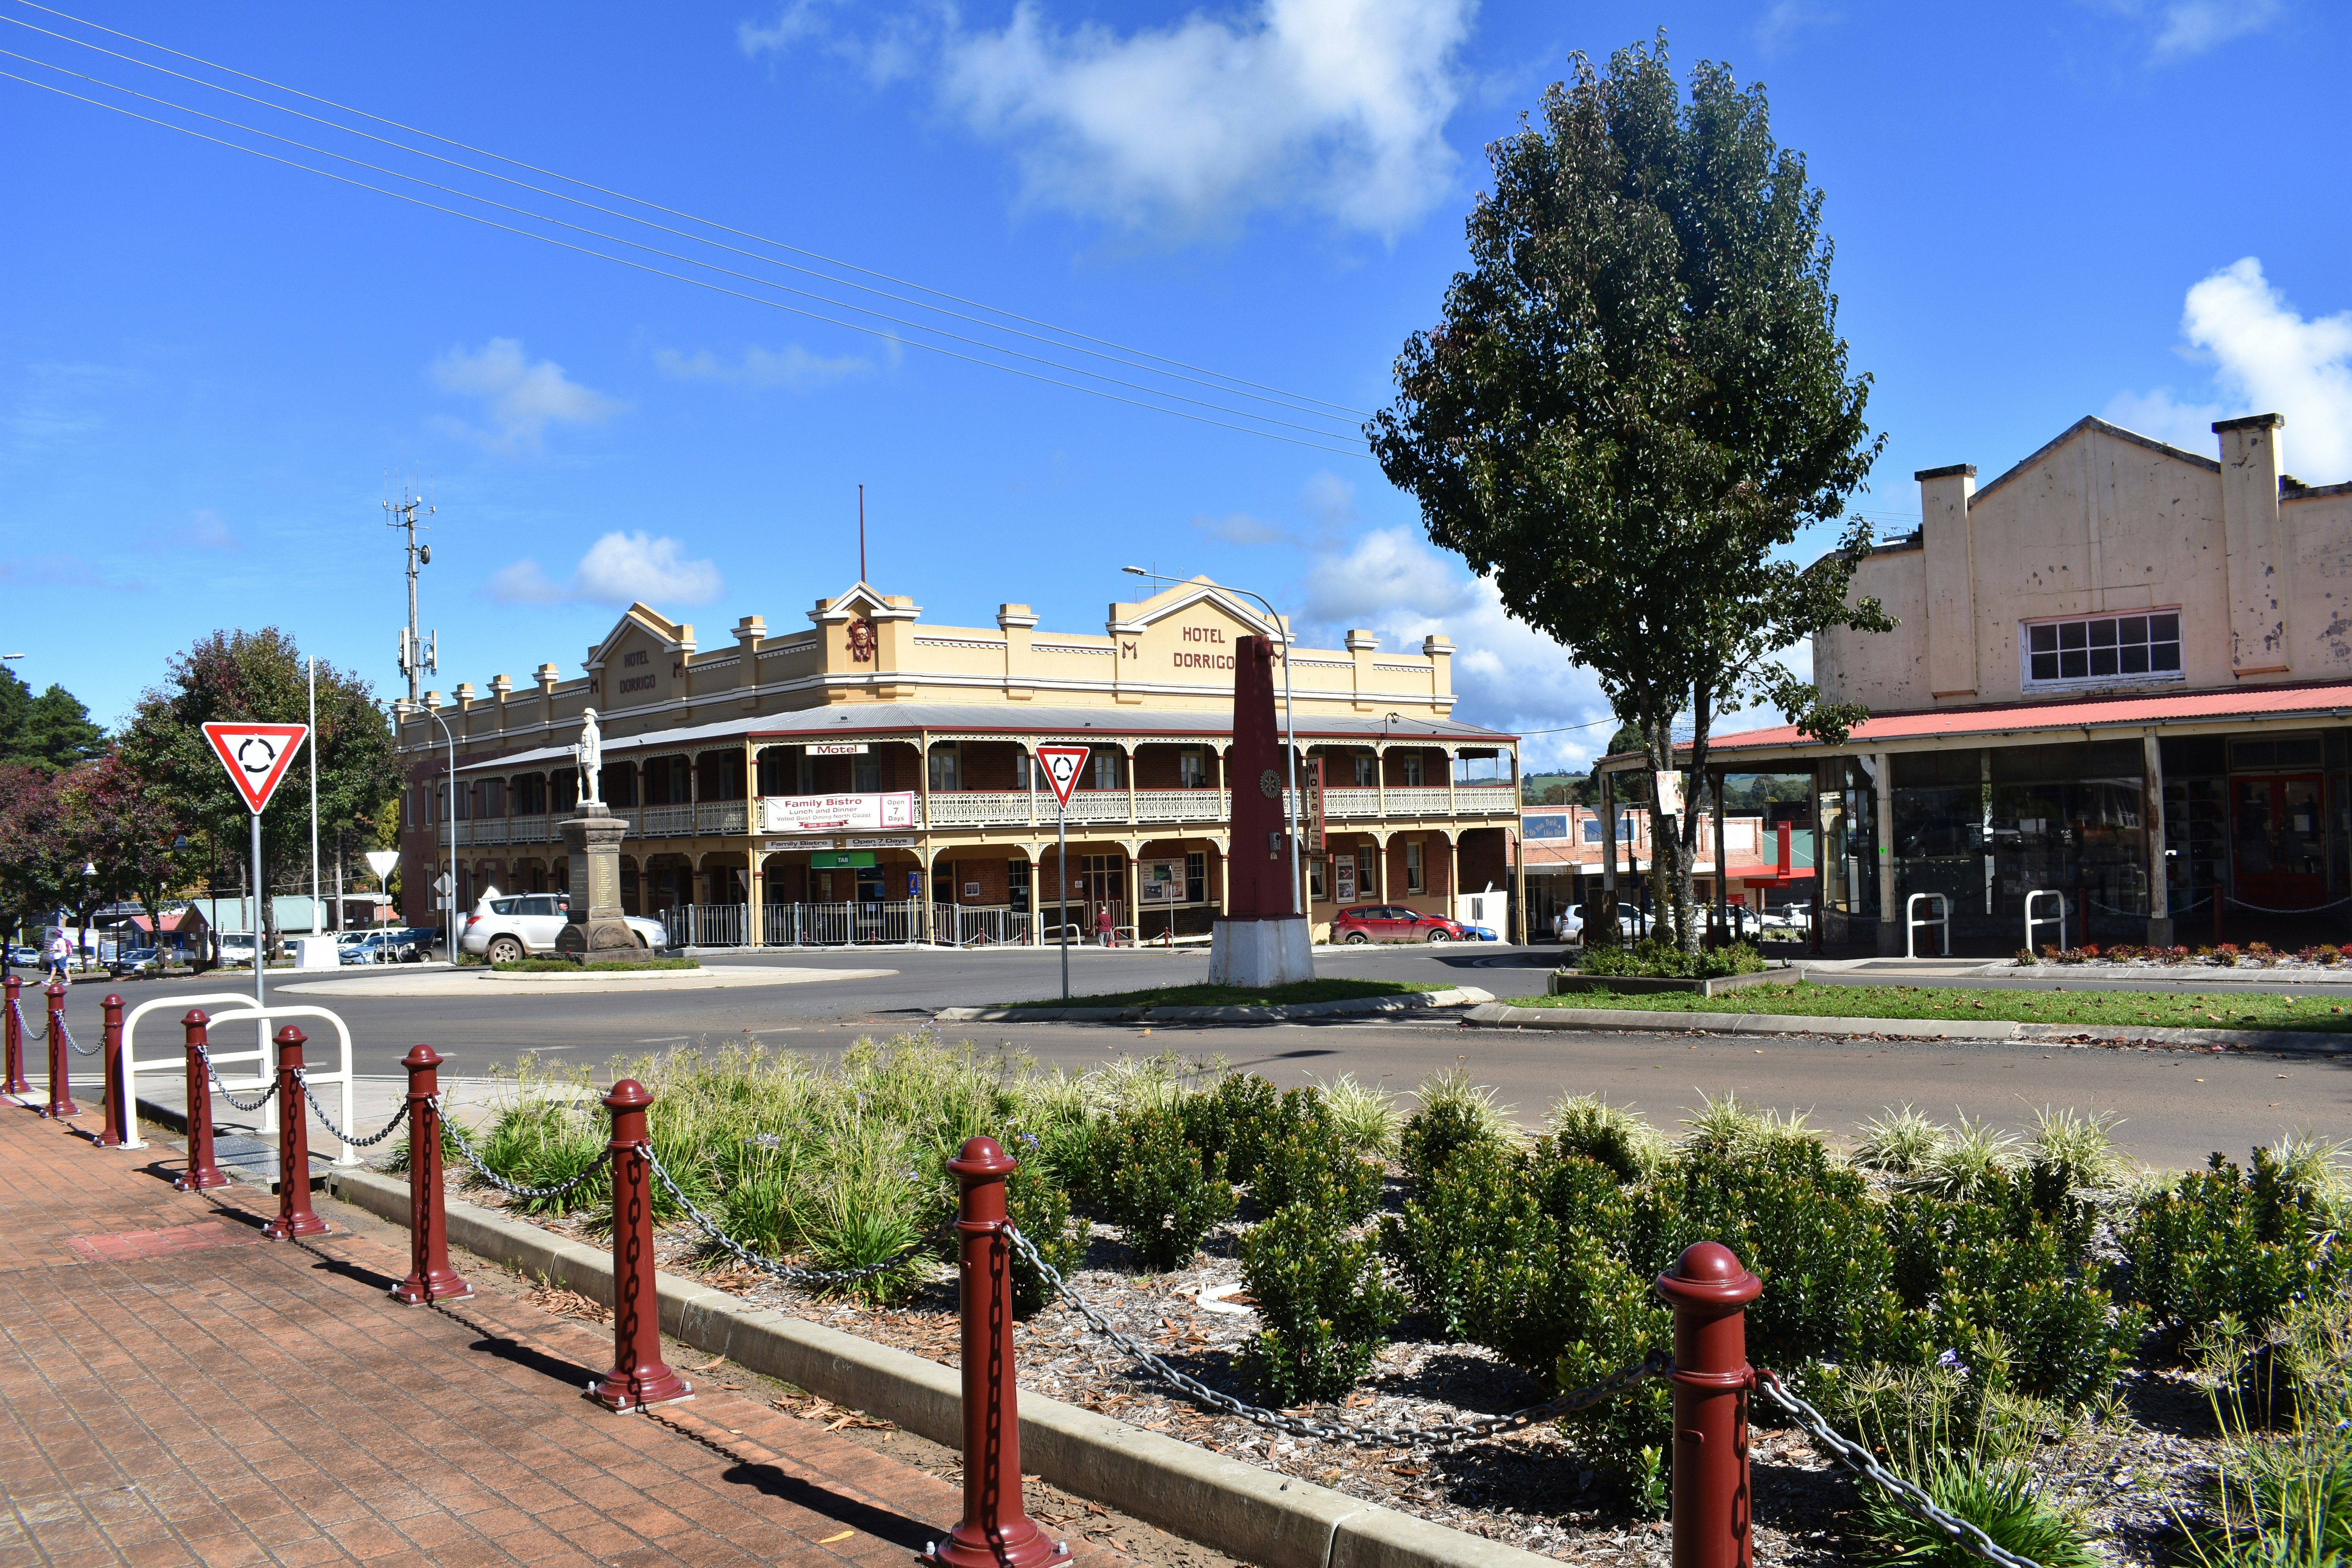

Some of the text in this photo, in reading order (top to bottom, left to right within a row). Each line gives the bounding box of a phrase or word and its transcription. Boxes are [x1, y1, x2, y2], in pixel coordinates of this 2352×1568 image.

[1183, 627, 1225, 643] HOTEL
[624, 650, 649, 668] HOTEL
[1174, 652, 1235, 670] DORRIGO
[620, 674, 655, 694] DORRIGO
[817, 745, 857, 754] Motel
[1309, 764, 1318, 826] Motel
